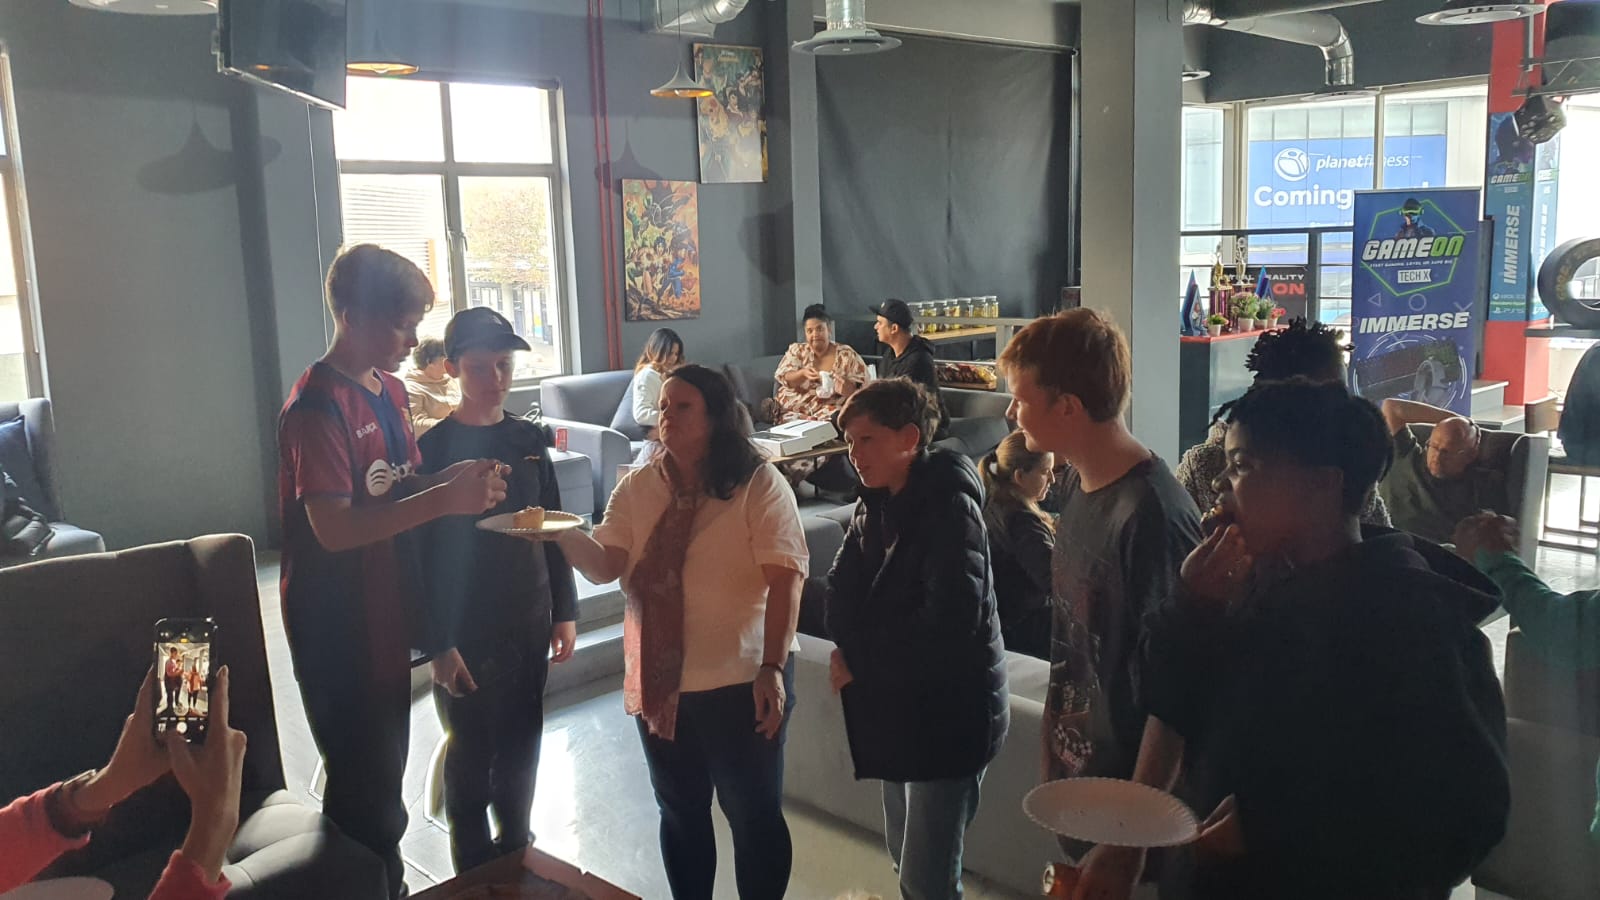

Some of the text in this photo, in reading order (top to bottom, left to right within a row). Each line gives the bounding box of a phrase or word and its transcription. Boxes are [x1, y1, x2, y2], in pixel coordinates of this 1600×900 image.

[1315, 153, 1409, 172] planetfiess
[1254, 184, 1354, 210] Coming
[1503, 204, 1520, 285] IMMERSE
[1399, 270, 1430, 282] TECH X
[1359, 312, 1470, 334] IMMERSE
